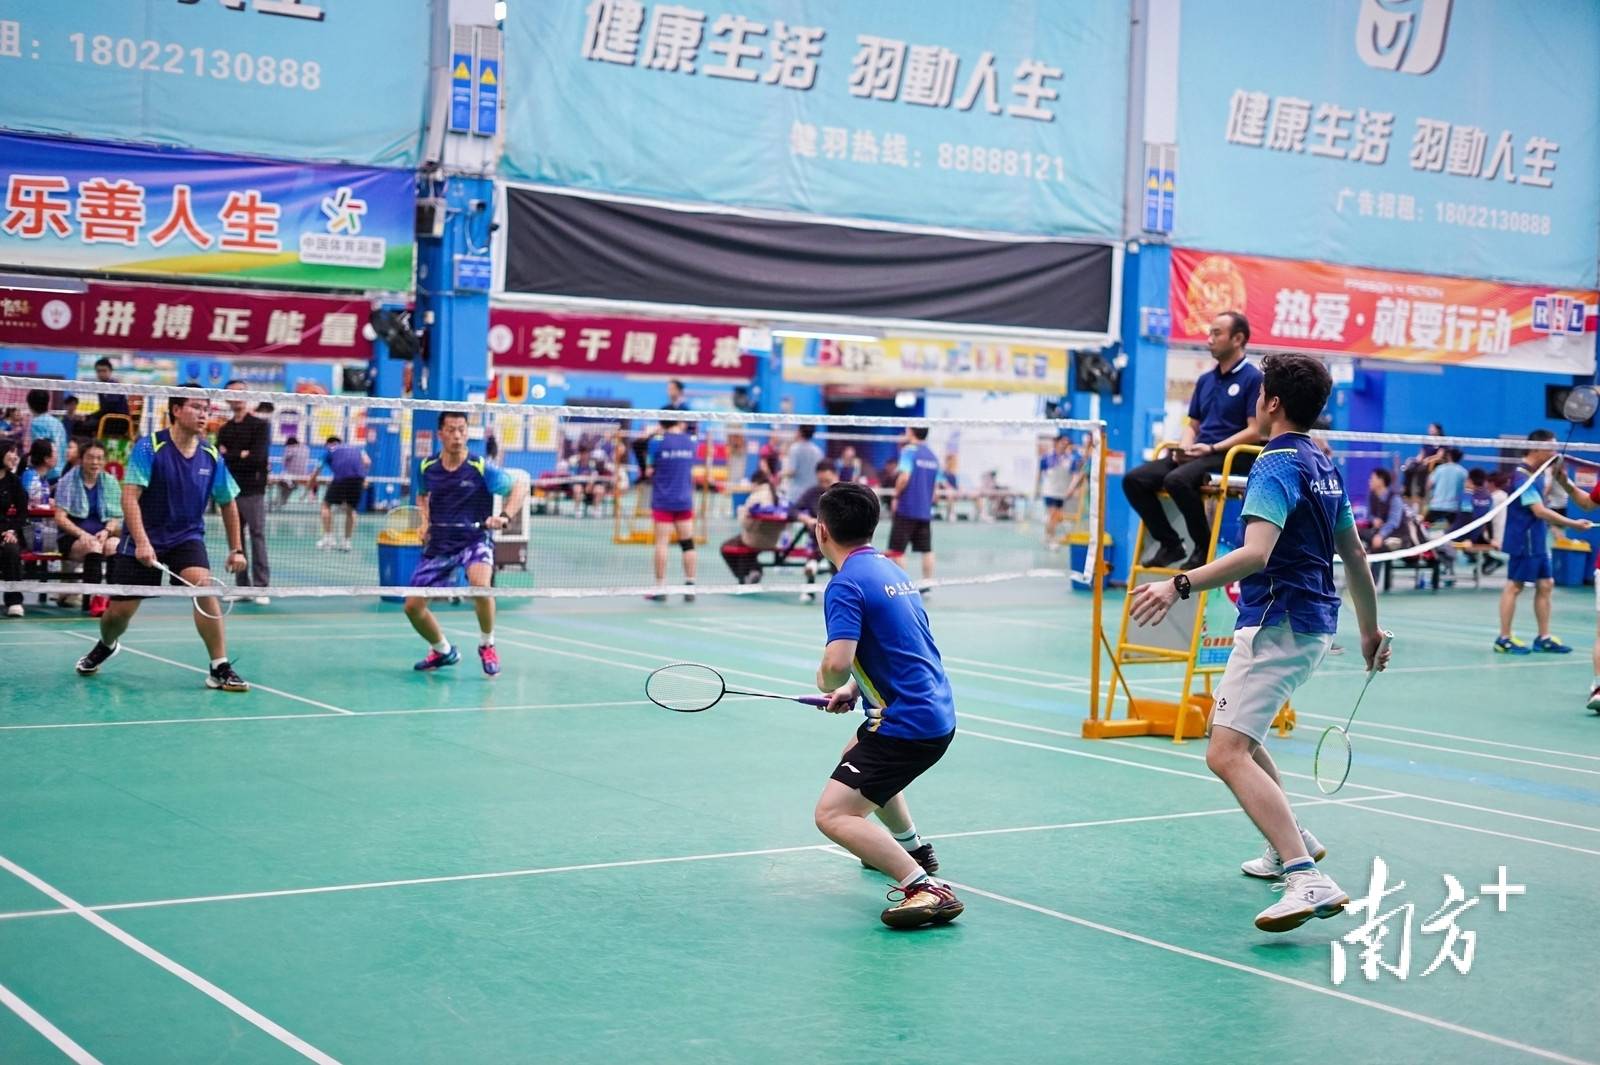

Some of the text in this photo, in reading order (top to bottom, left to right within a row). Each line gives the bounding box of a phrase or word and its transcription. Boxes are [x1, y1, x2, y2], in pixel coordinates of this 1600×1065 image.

[69, 32, 322, 91] 18022130888
[581, 0, 1064, 122] 健康生活 羽動人生
[936, 143, 1066, 182] 88888121
[1225, 88, 1561, 188] 健康生活 羽動人生
[2, 174, 283, 253] 乐善人生
[1435, 201, 1552, 236] 18022130888
[93, 299, 360, 348] 拼搏正能量
